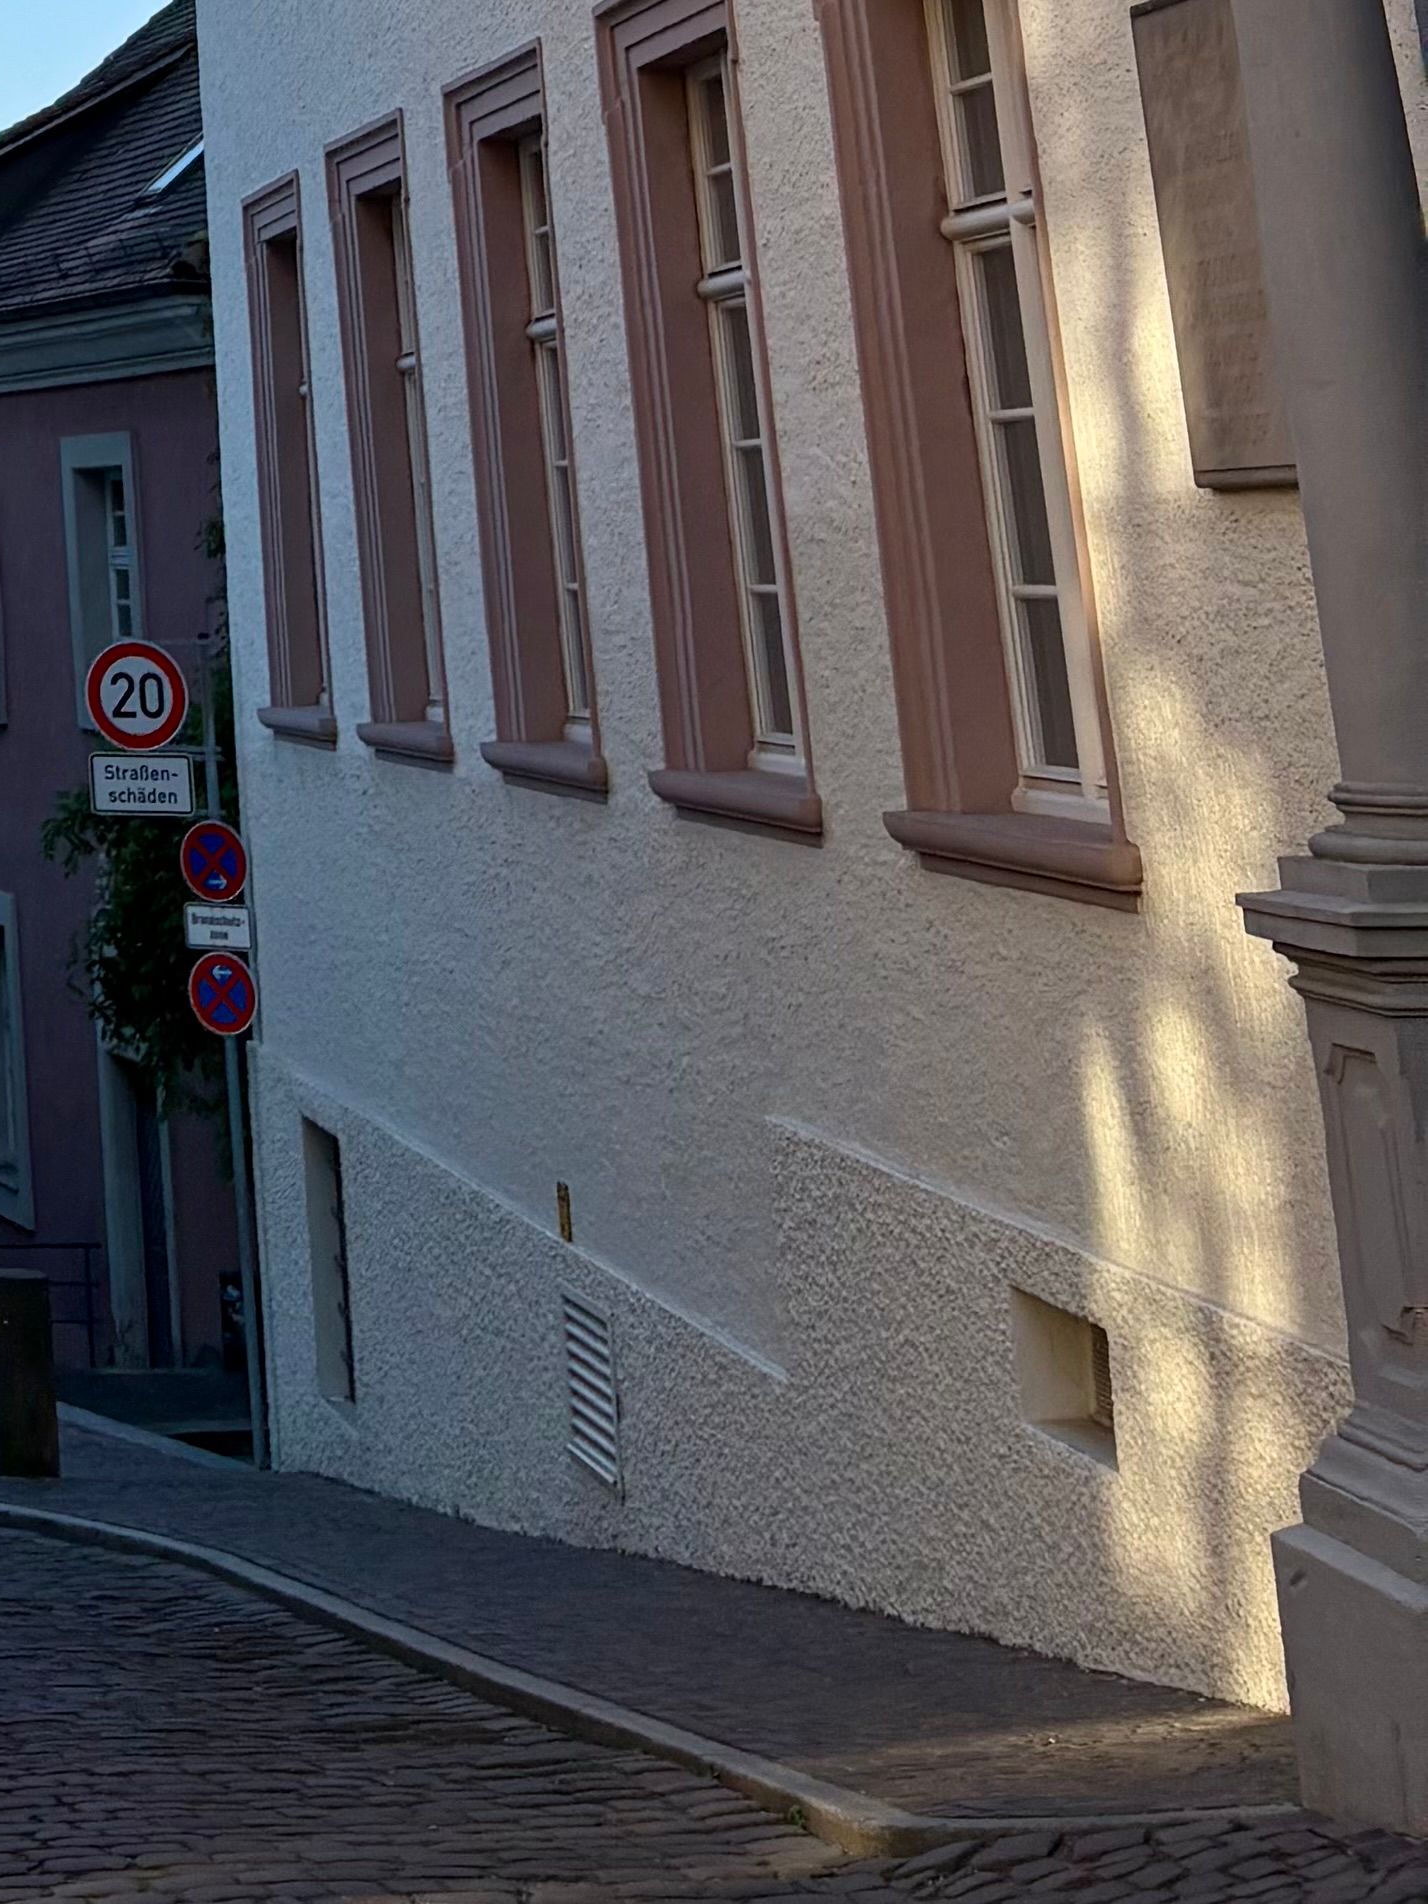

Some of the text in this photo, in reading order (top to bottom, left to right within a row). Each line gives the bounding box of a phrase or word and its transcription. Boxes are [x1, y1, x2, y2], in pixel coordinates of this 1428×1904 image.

[110, 671, 165, 719] 20
[104, 764, 179, 781] Straßen-
[108, 787, 178, 804] schäden
